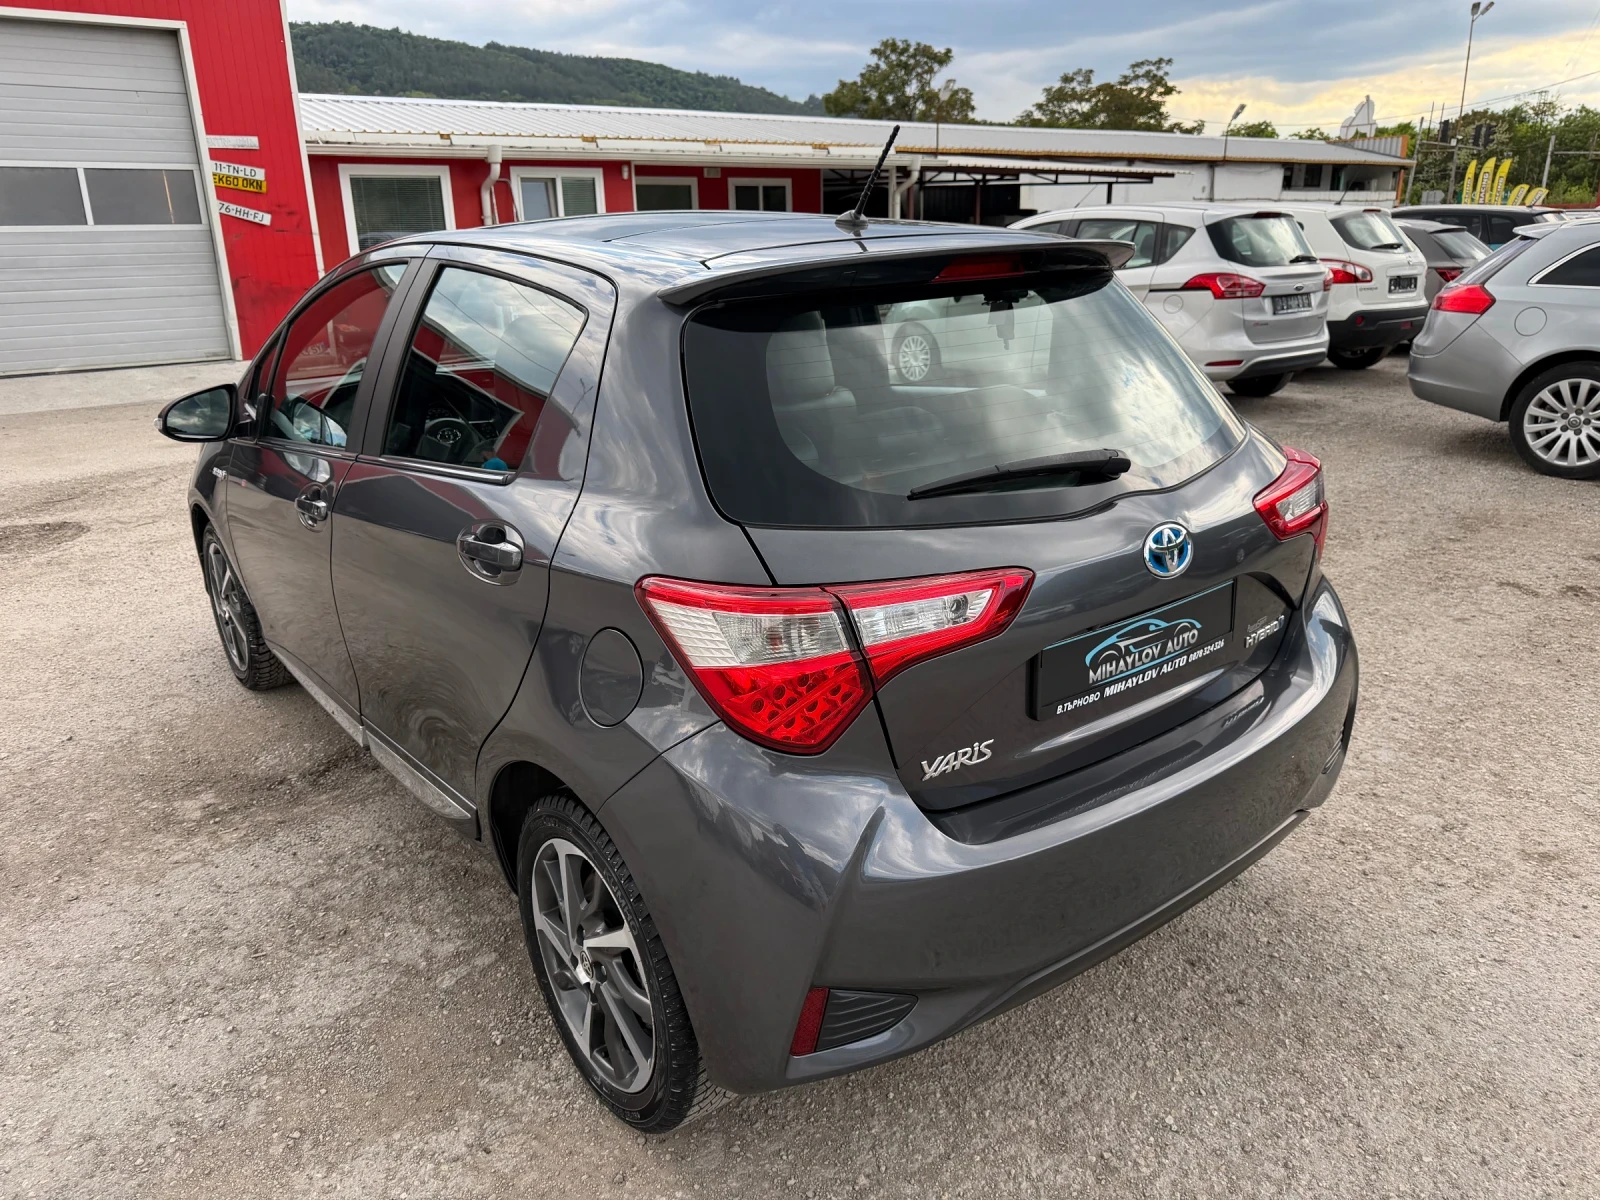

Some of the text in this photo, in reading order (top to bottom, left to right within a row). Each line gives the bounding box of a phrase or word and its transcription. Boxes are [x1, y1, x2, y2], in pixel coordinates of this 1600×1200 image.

[1479, 172, 1489, 204] RACING
[1245, 620, 1281, 648] HYBRID
[1089, 629, 1199, 684] MIHAYLOV AUTO
[1104, 667, 1158, 698] MIHAYLOV
[1160, 655, 1188, 675] AUTO
